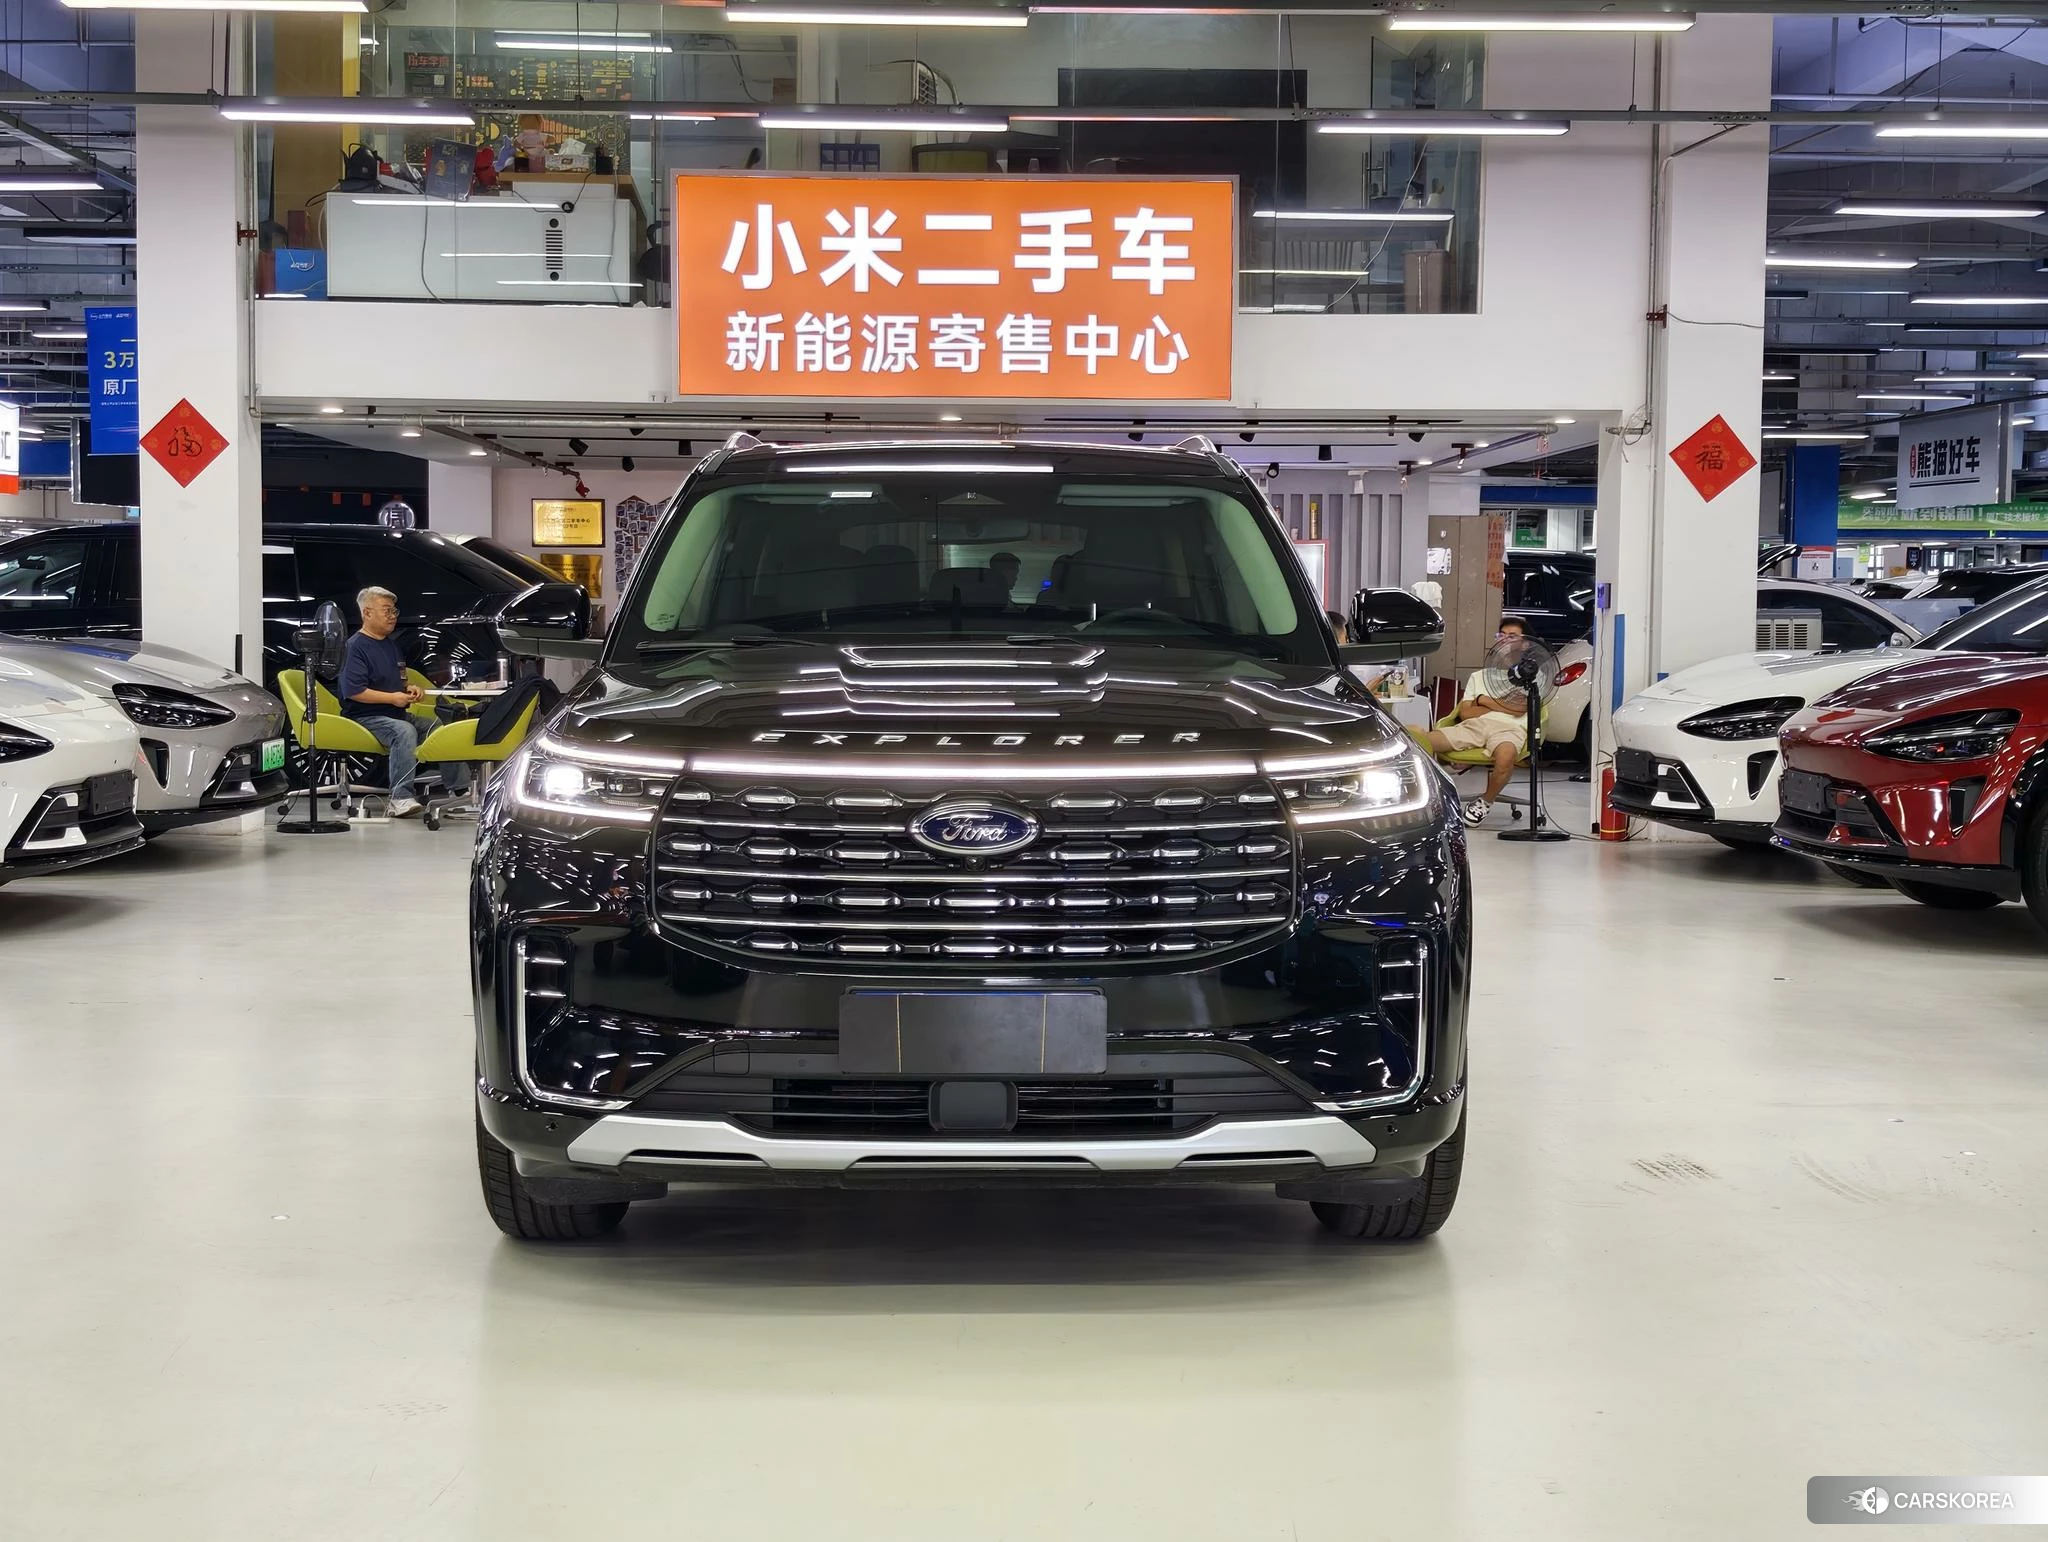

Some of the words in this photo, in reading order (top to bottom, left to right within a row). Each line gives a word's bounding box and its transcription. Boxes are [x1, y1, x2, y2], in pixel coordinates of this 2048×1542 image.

[721, 203, 1197, 295] 小米二手车
[725, 310, 1190, 375] 新能源寄售中心
[103, 351, 135, 369] 3万
[1695, 443, 1725, 472] 福
[1916, 435, 1981, 479] 熊猫好车
[752, 731, 1202, 746] EXPLORER
[939, 814, 1008, 842] Ford
